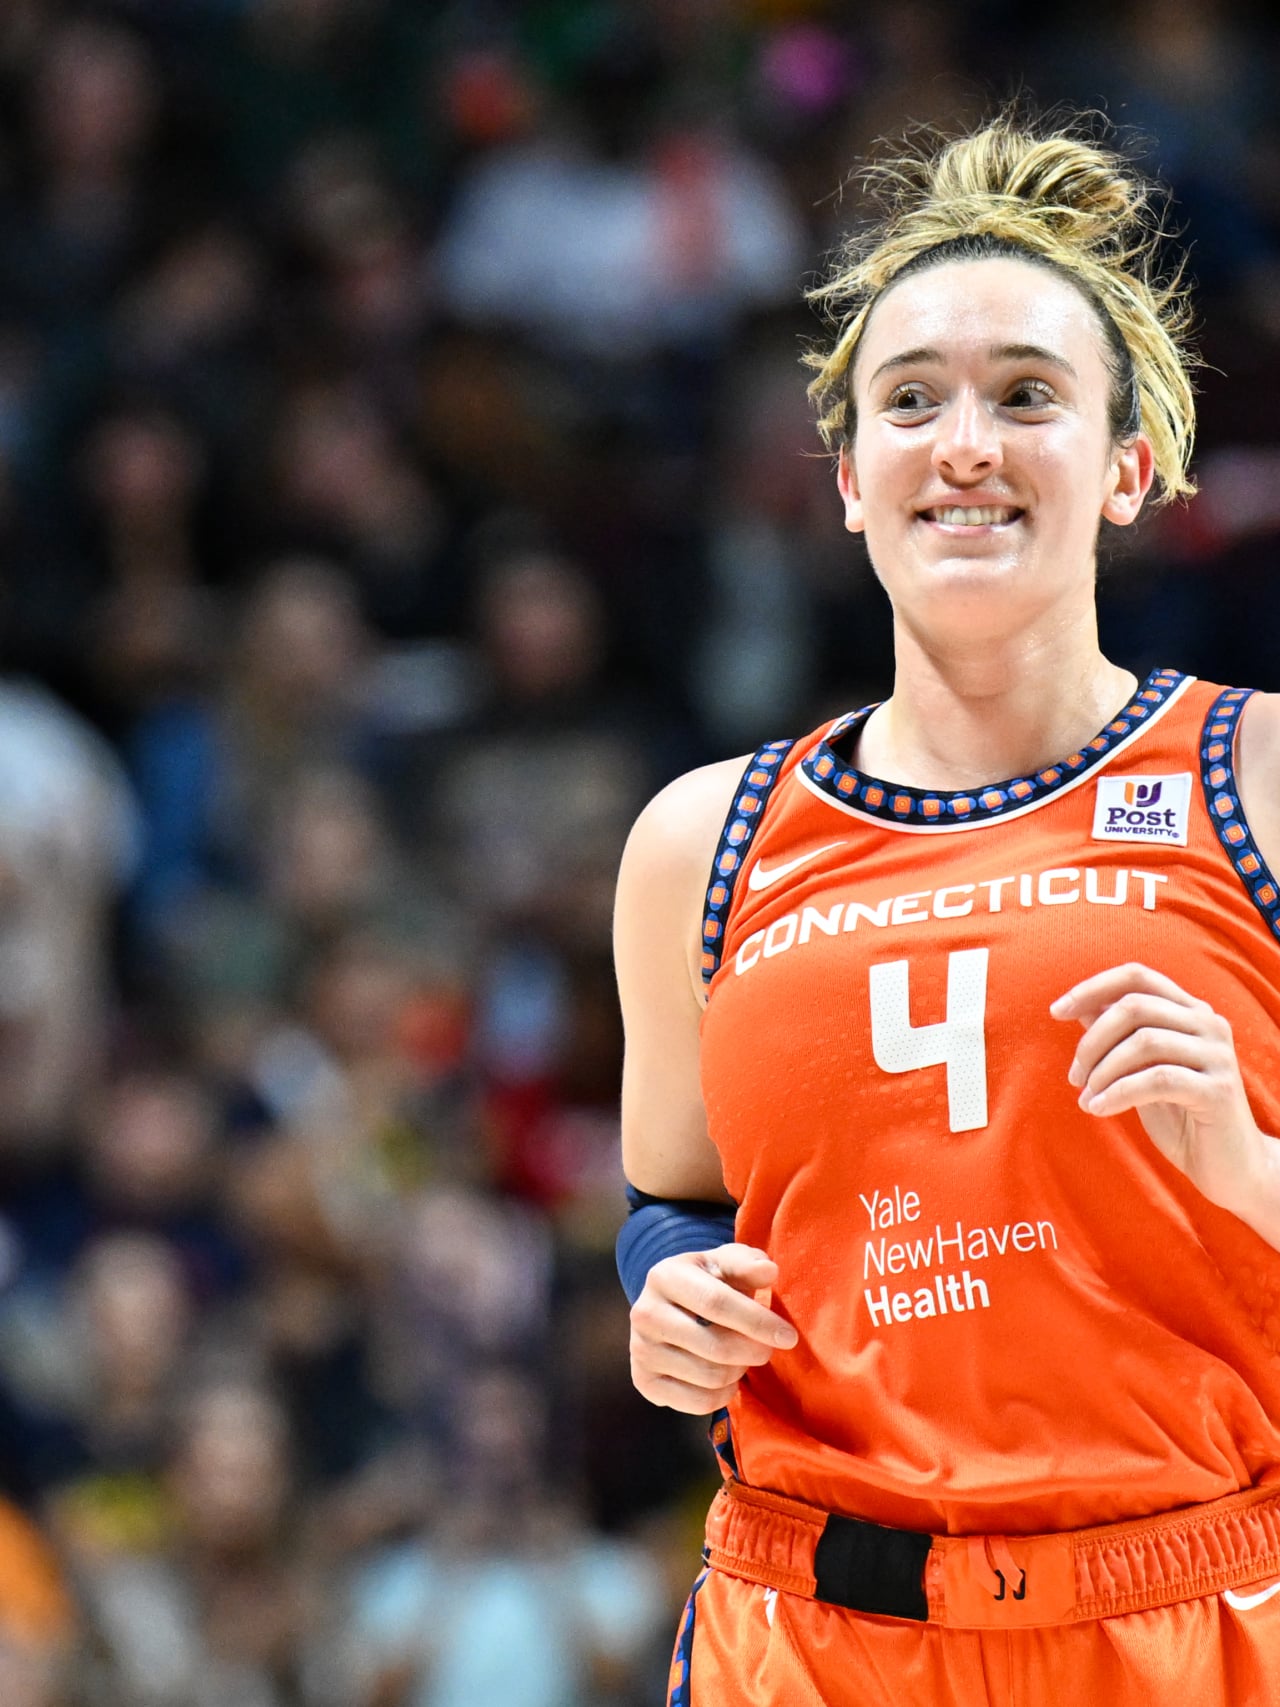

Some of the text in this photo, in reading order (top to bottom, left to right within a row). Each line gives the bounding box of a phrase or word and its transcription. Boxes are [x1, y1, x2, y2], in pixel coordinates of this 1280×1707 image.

[1106, 807, 1176, 827] Post
[734, 868, 1168, 976] CONNECTICUT
[869, 948, 989, 1133] 4
[859, 1185, 921, 1231] Yale
[864, 1271, 991, 1327] Health
